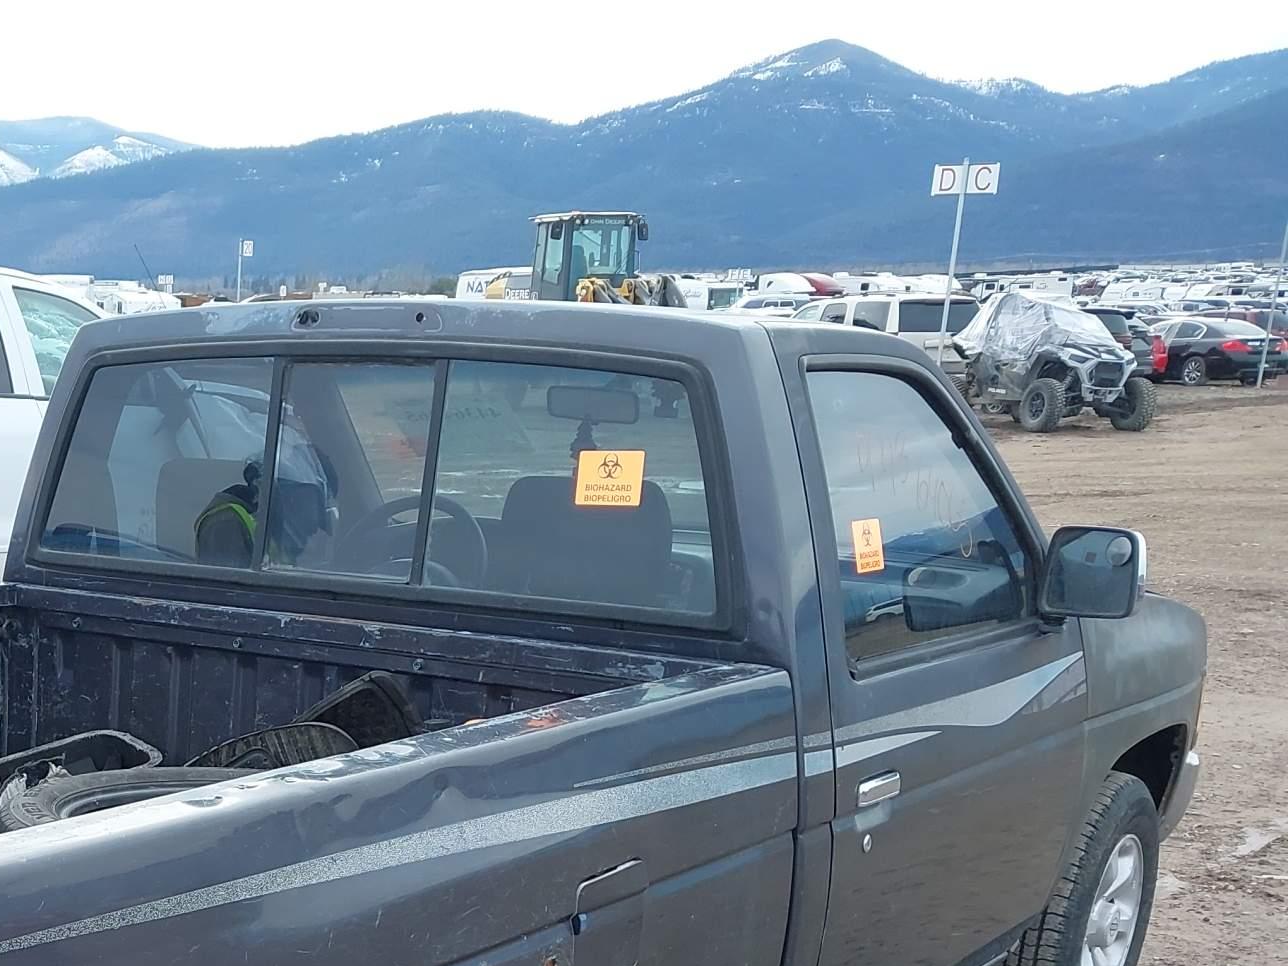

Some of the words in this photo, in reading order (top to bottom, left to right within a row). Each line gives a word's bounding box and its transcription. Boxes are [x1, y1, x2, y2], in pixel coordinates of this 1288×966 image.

[939, 168, 956, 192] D
[975, 166, 992, 191] C
[505, 287, 531, 300] DEERE
[585, 483, 632, 492] BIOHAZARD
[583, 494, 632, 503] BIOPELIGRO
